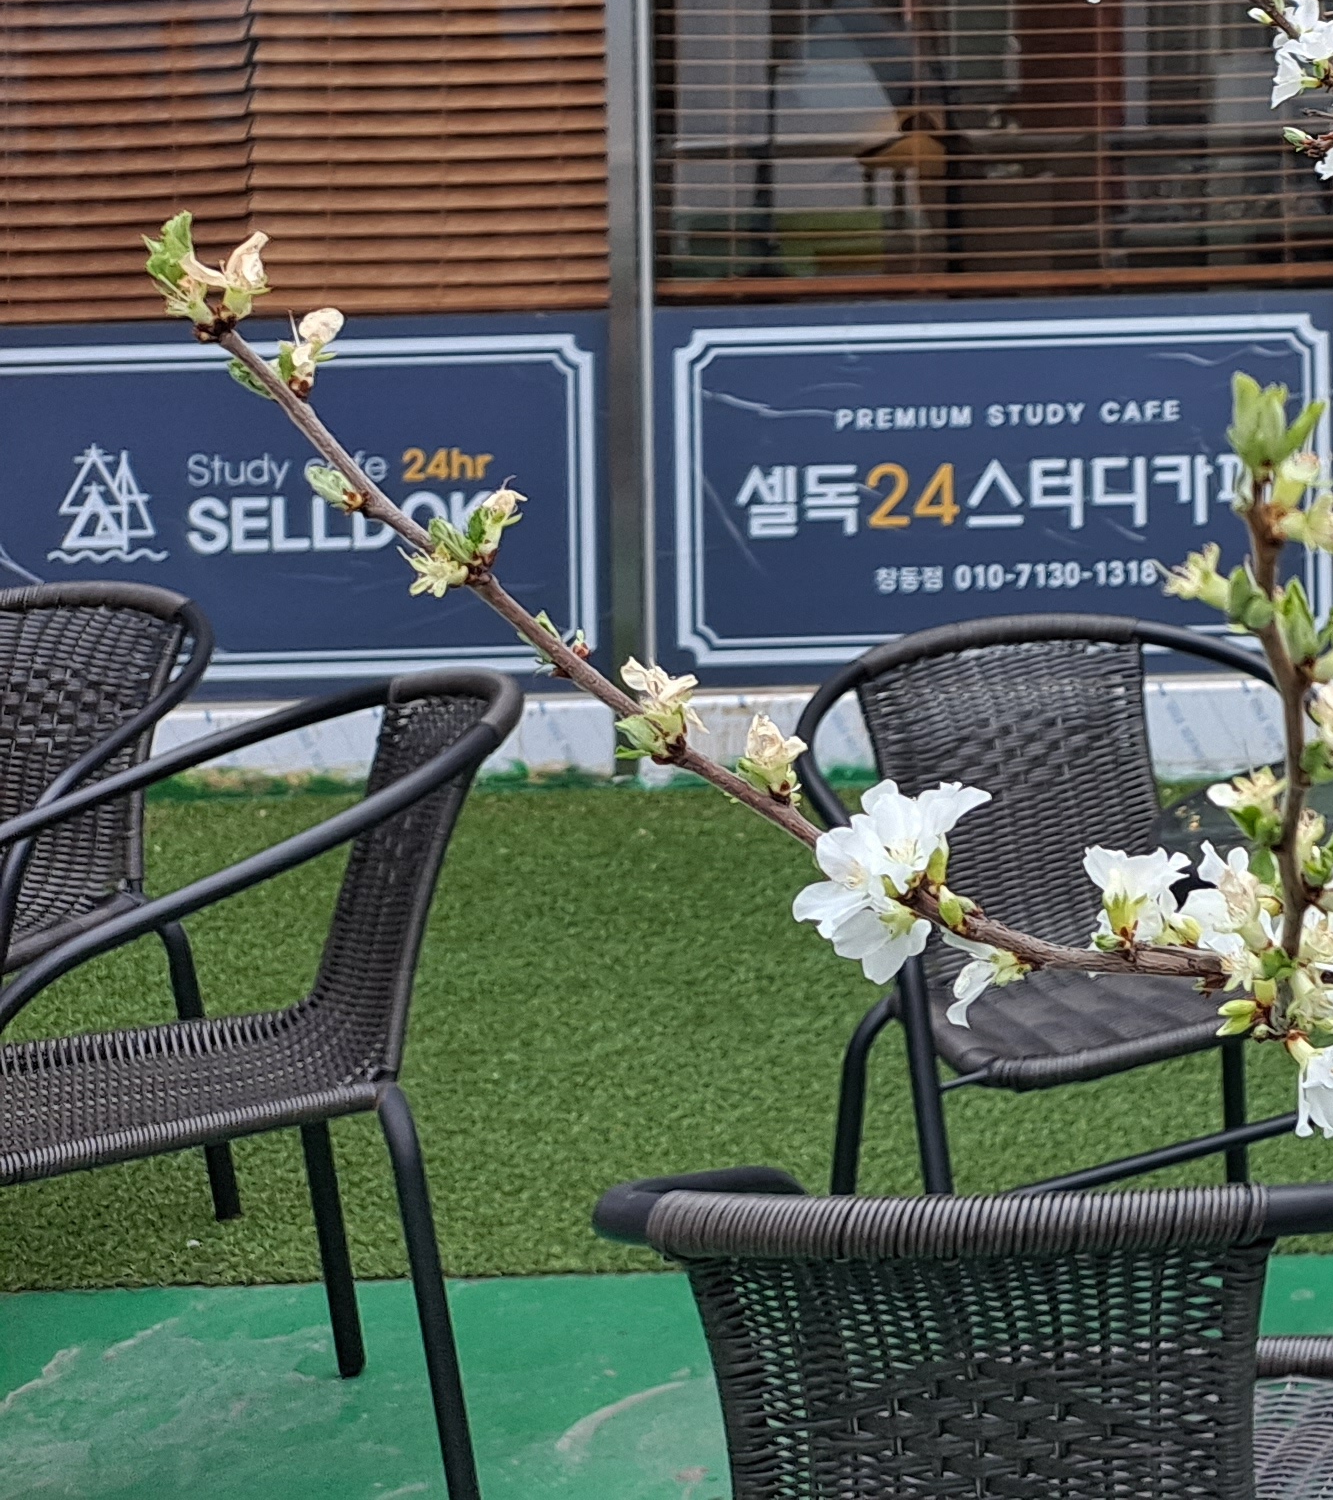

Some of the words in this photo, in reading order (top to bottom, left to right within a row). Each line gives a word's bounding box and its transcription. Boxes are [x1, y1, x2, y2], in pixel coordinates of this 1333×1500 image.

[834, 405, 973, 430] PREMIUM
[986, 402, 1085, 427] STUDY
[1100, 399, 1181, 423] CAFE
[187, 452, 290, 489] Study
[402, 448, 494, 482] 24hr
[875, 566, 943, 594] 창동점
[953, 558, 1158, 592] 010-7130-1318
